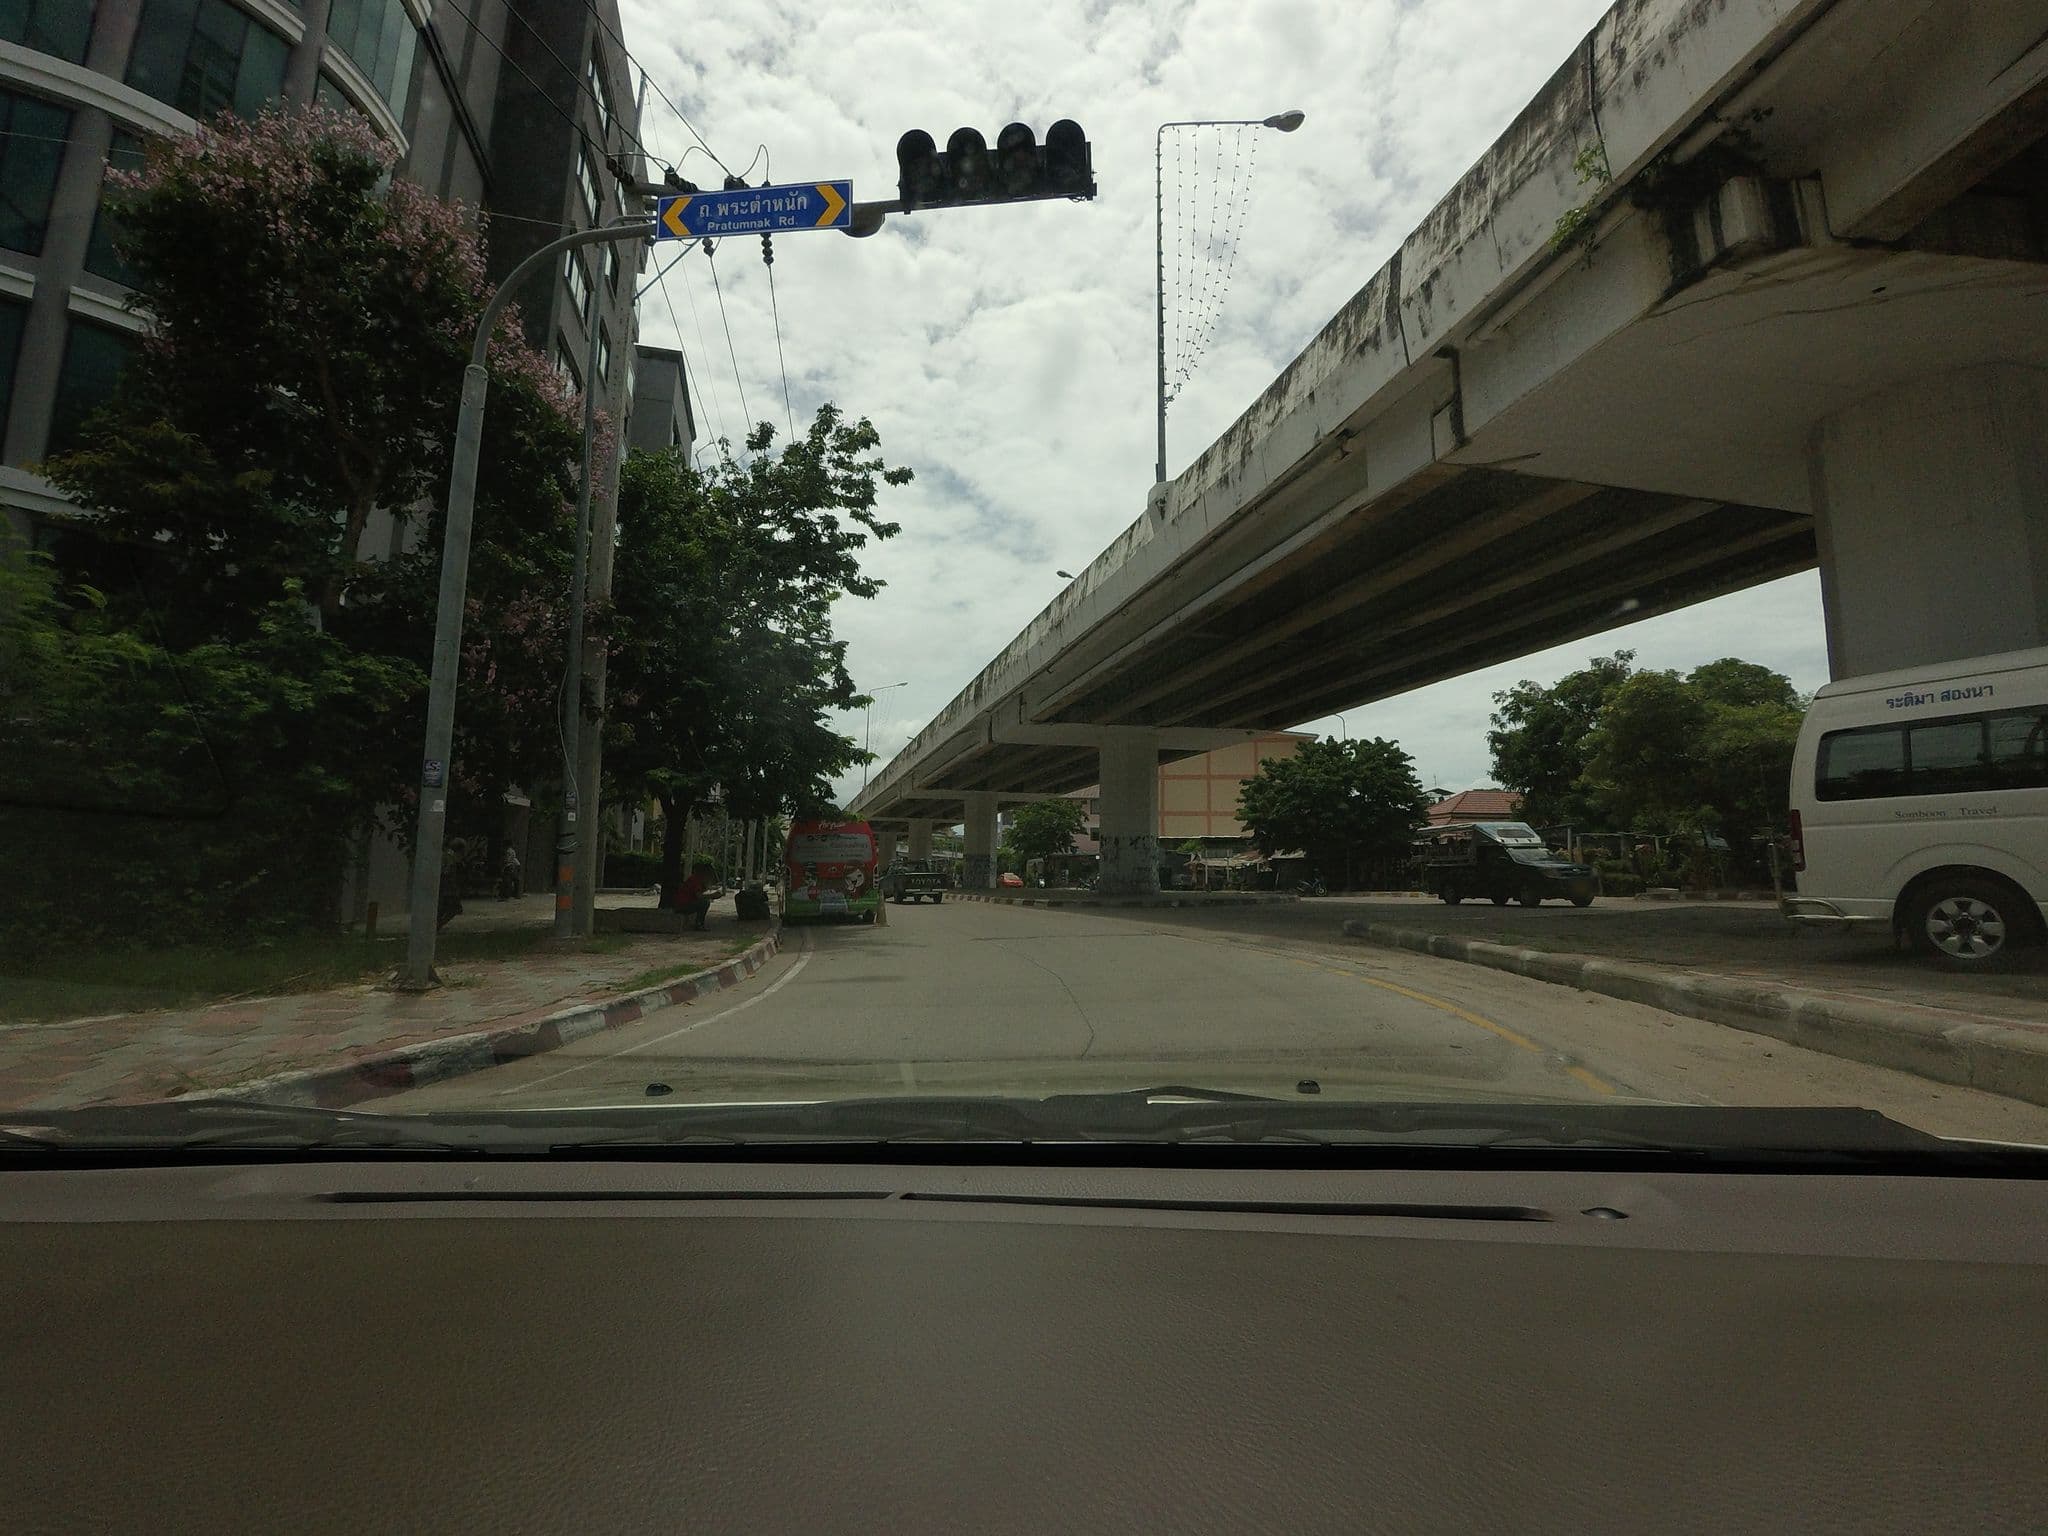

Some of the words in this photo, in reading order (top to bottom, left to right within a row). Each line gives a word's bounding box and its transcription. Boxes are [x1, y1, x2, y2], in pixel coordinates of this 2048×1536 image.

[717, 190, 808, 217] พระตำหนัก
[707, 217, 771, 231] Pratumnak
[1959, 806, 1998, 816] Travel
[911, 877, 942, 885] TOYOTA
